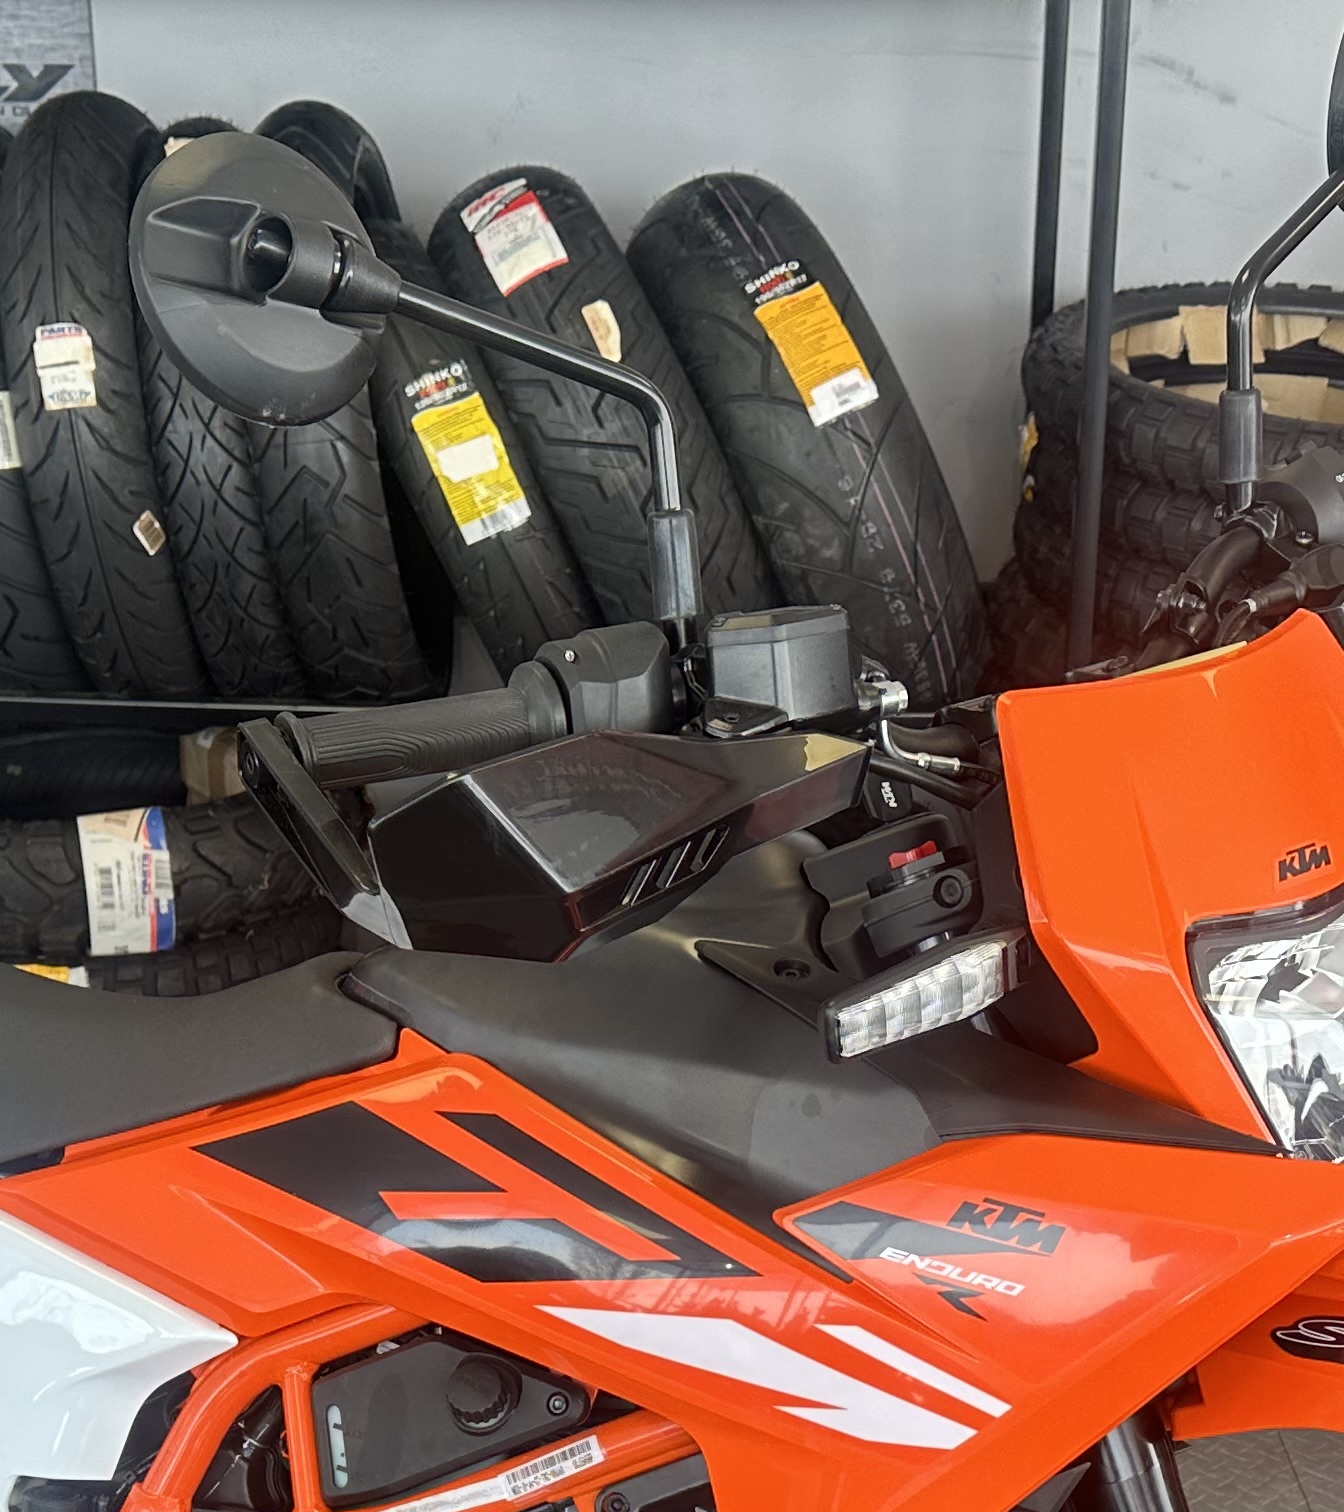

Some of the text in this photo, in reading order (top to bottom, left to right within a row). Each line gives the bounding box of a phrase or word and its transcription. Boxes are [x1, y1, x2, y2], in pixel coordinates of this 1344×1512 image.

[744, 261, 800, 294] SHINKO
[1278, 842, 1332, 882] KTM
[946, 1197, 1066, 1254] KTM
[878, 1247, 1026, 1297] ENDURO
